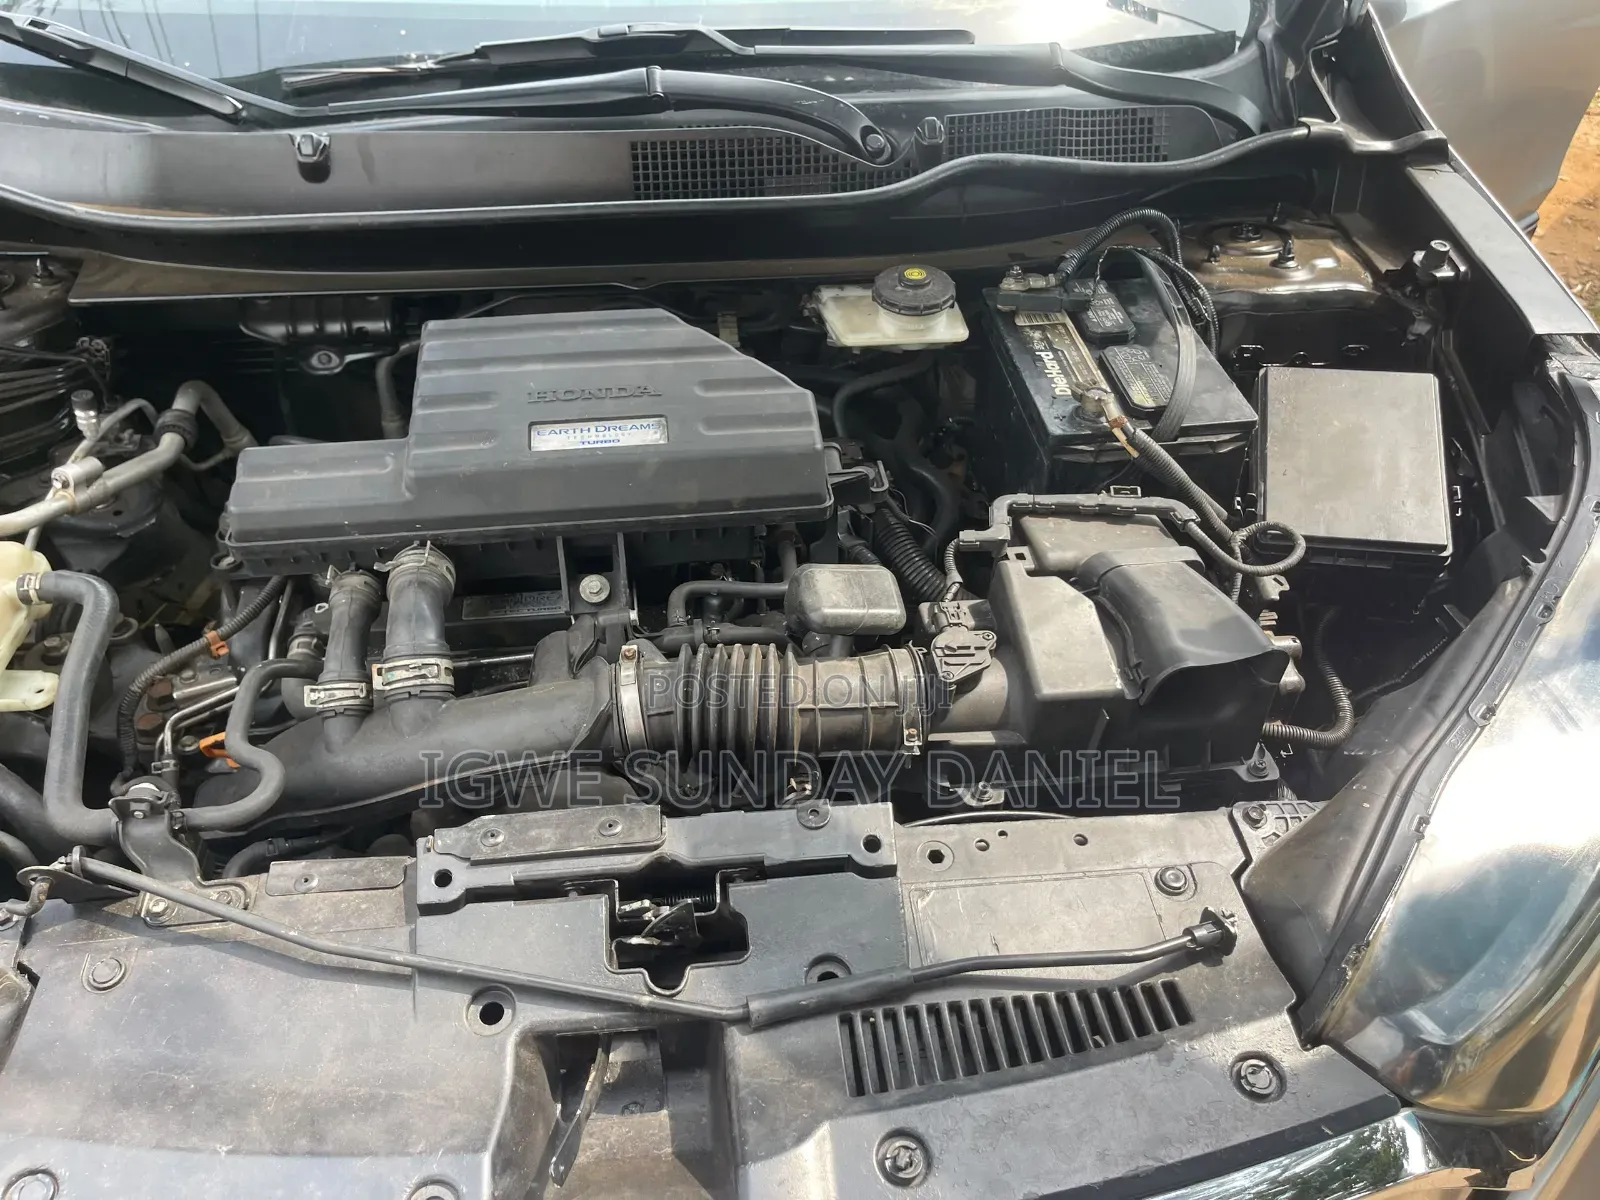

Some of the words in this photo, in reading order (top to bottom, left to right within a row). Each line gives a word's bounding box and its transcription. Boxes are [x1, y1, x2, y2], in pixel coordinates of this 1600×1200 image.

[1034, 351, 1072, 395] DieHard
[527, 385, 663, 404] HONDA
[536, 427, 591, 437] EARTH
[595, 422, 662, 433] DREAMS
[579, 438, 621, 446] TURBO
